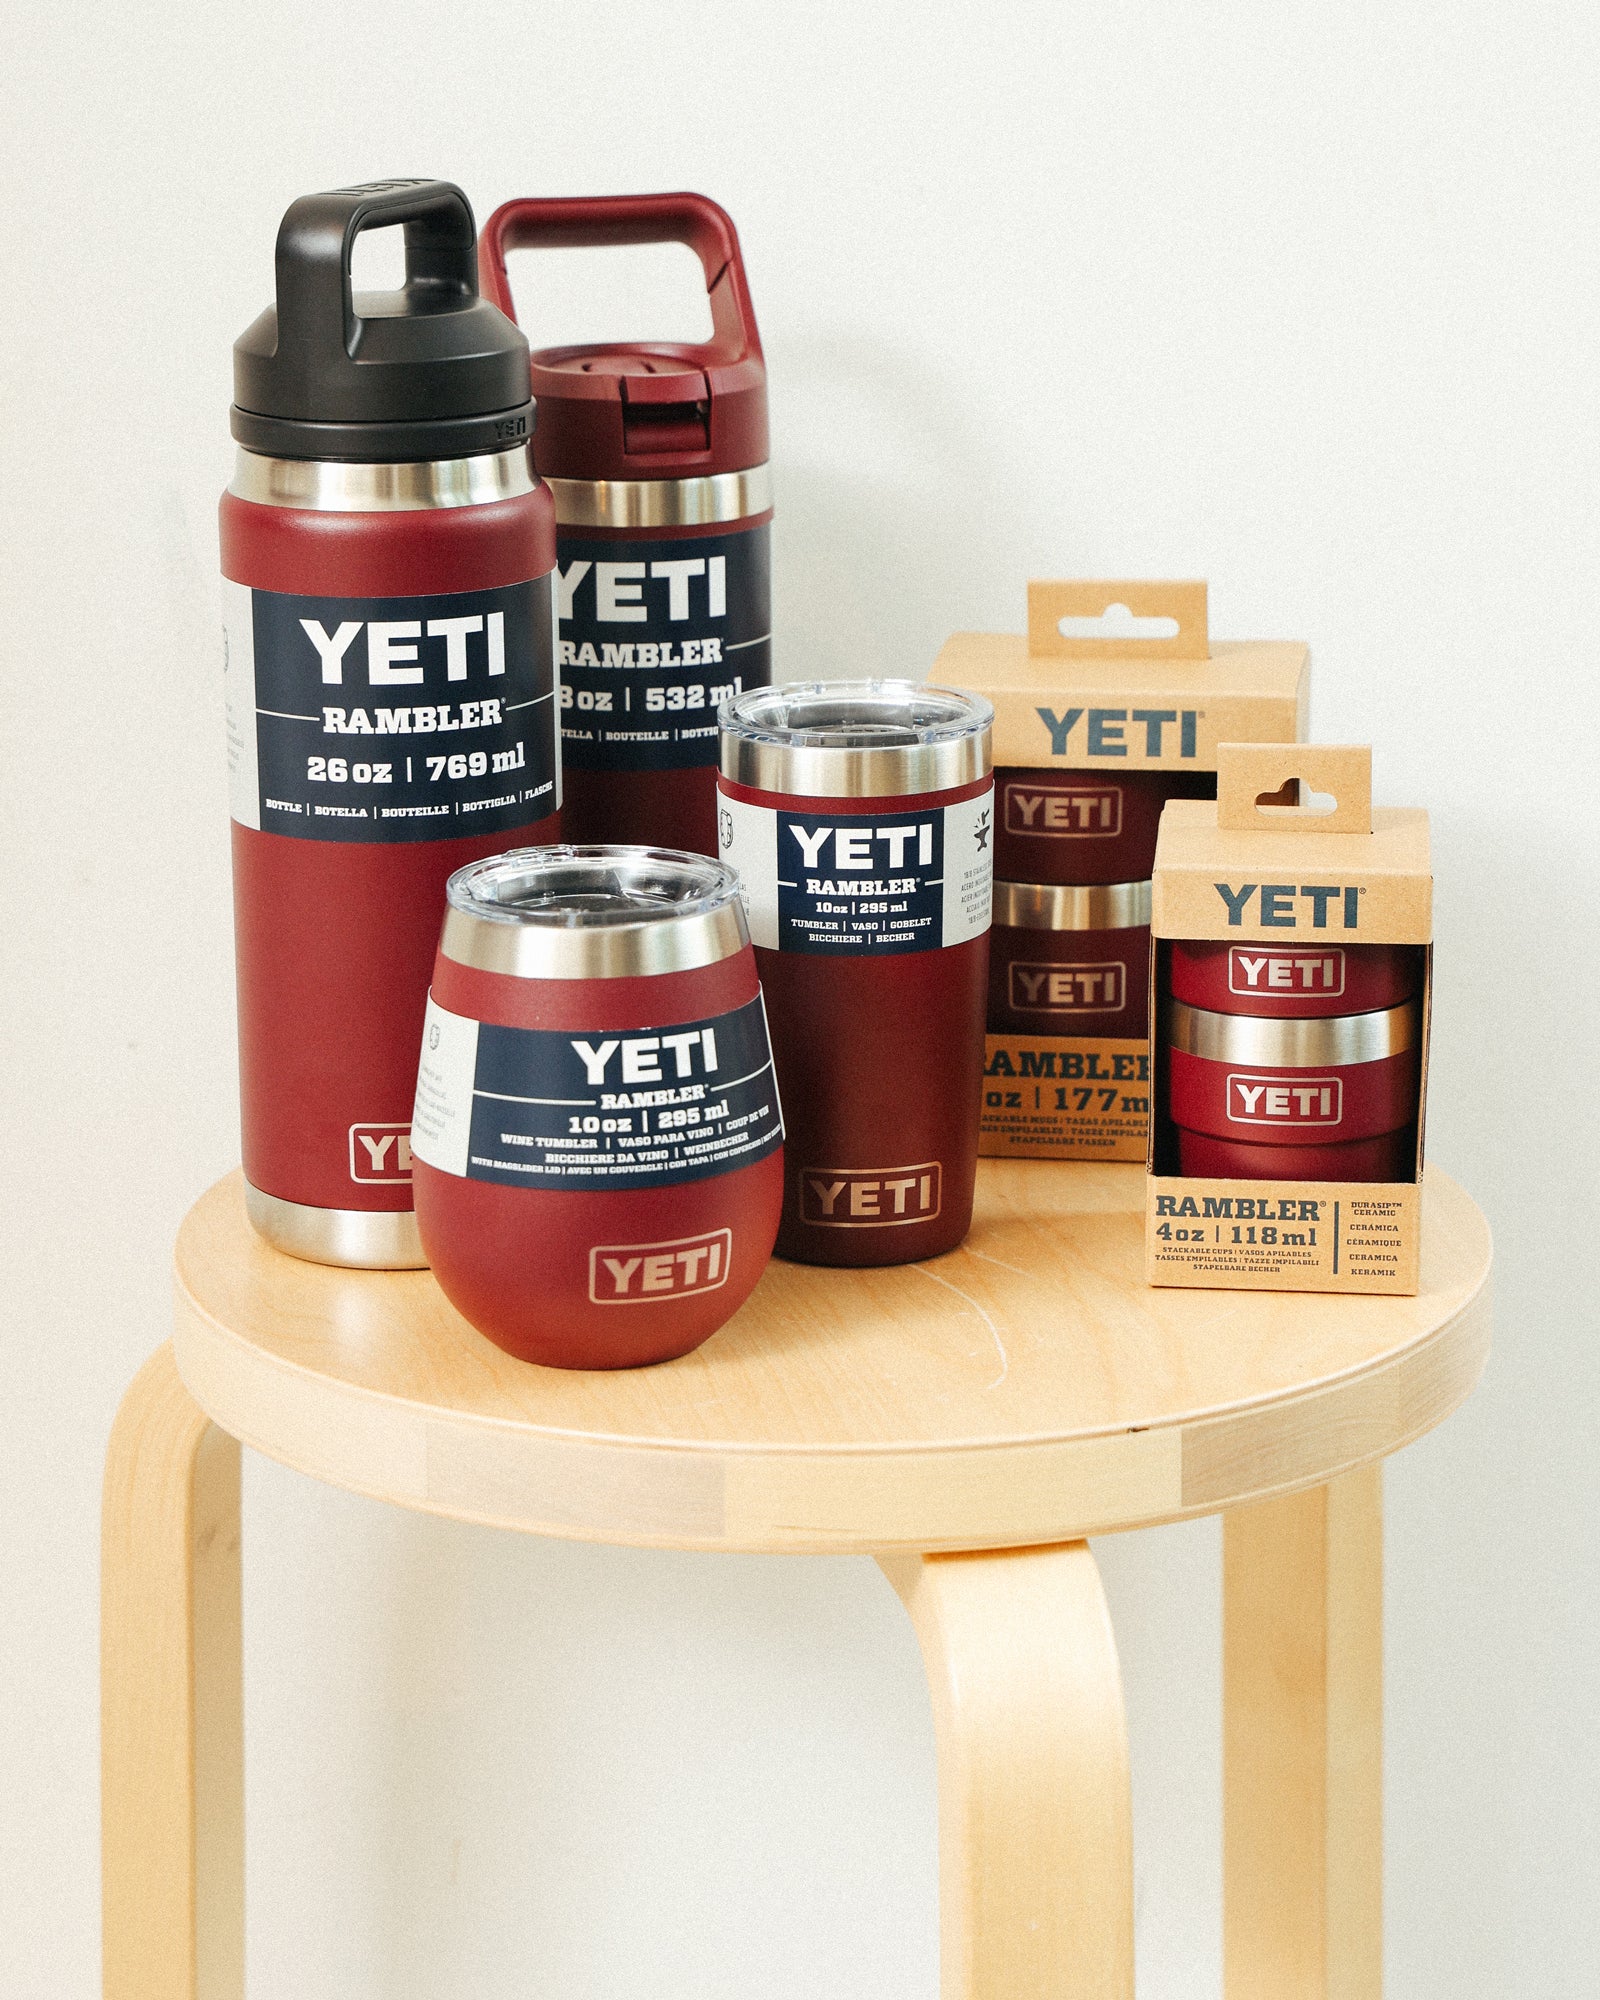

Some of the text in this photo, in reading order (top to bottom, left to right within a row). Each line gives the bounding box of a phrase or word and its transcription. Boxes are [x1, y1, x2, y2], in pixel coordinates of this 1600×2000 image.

[495, 416, 526, 439] YETI
[557, 555, 726, 622] YETI
[299, 611, 505, 685] YETI
[645, 685, 705, 711] 532
[606, 730, 669, 741] BOUTEILLE
[266, 780, 553, 818] BOTTLE BOTELLA BOUTEILLE BOTTIGLIA FLASCHE
[1016, 794, 1111, 828] YETI
[788, 823, 933, 870] YETI
[860, 902, 888, 914] 295
[890, 901, 908, 912] ml
[791, 917, 932, 931] TUMBLER VASO GOBELET
[809, 932, 915, 943] BICCHIERE BECHER
[1237, 957, 1334, 988] YETI
[1018, 972, 1116, 1003] YETI
[571, 1028, 718, 1085] YETI
[658, 1107, 700, 1129] 295
[704, 1099, 729, 1121] ml
[1235, 1084, 1330, 1116] YETI
[501, 1133, 534, 1147] WINE
[535, 1137, 597, 1149] TUMBLER
[618, 1136, 651, 1148] VASO
[653, 1133, 685, 1145] PARA
[687, 1126, 714, 1140] VINO
[726, 1116, 749, 1131] COUP
[749, 1110, 759, 1123] DE
[545, 1132, 749, 1164] BICCHIERE DA VINO WEINBECHER
[471, 1156, 493, 1167] WITH
[494, 1160, 544, 1173] MAGSLIDER
[545, 1165, 561, 1175] LID
[567, 1166, 592, 1175] AVEC
[593, 1166, 608, 1175] UN
[609, 1162, 663, 1175] COUVERCLE
[669, 1159, 687, 1169] CON
[689, 1155, 709, 1166] TAPA
[713, 1151, 729, 1161] CON
[808, 1175, 932, 1215] YETI
[1354, 1209, 1396, 1217] CERAMIC
[1163, 1246, 1210, 1254] STACKABLE
[1266, 1250, 1312, 1258] APILABLES
[1346, 1238, 1402, 1247] CÉRAMIQUE
[602, 1242, 721, 1293] YETI
[1193, 1264, 1246, 1272] STAPELBARE
[1272, 1258, 1319, 1266] IMPILABILI
[1349, 1253, 1398, 1262] CERAMICA
[1351, 1268, 1396, 1276] KERAMIK
